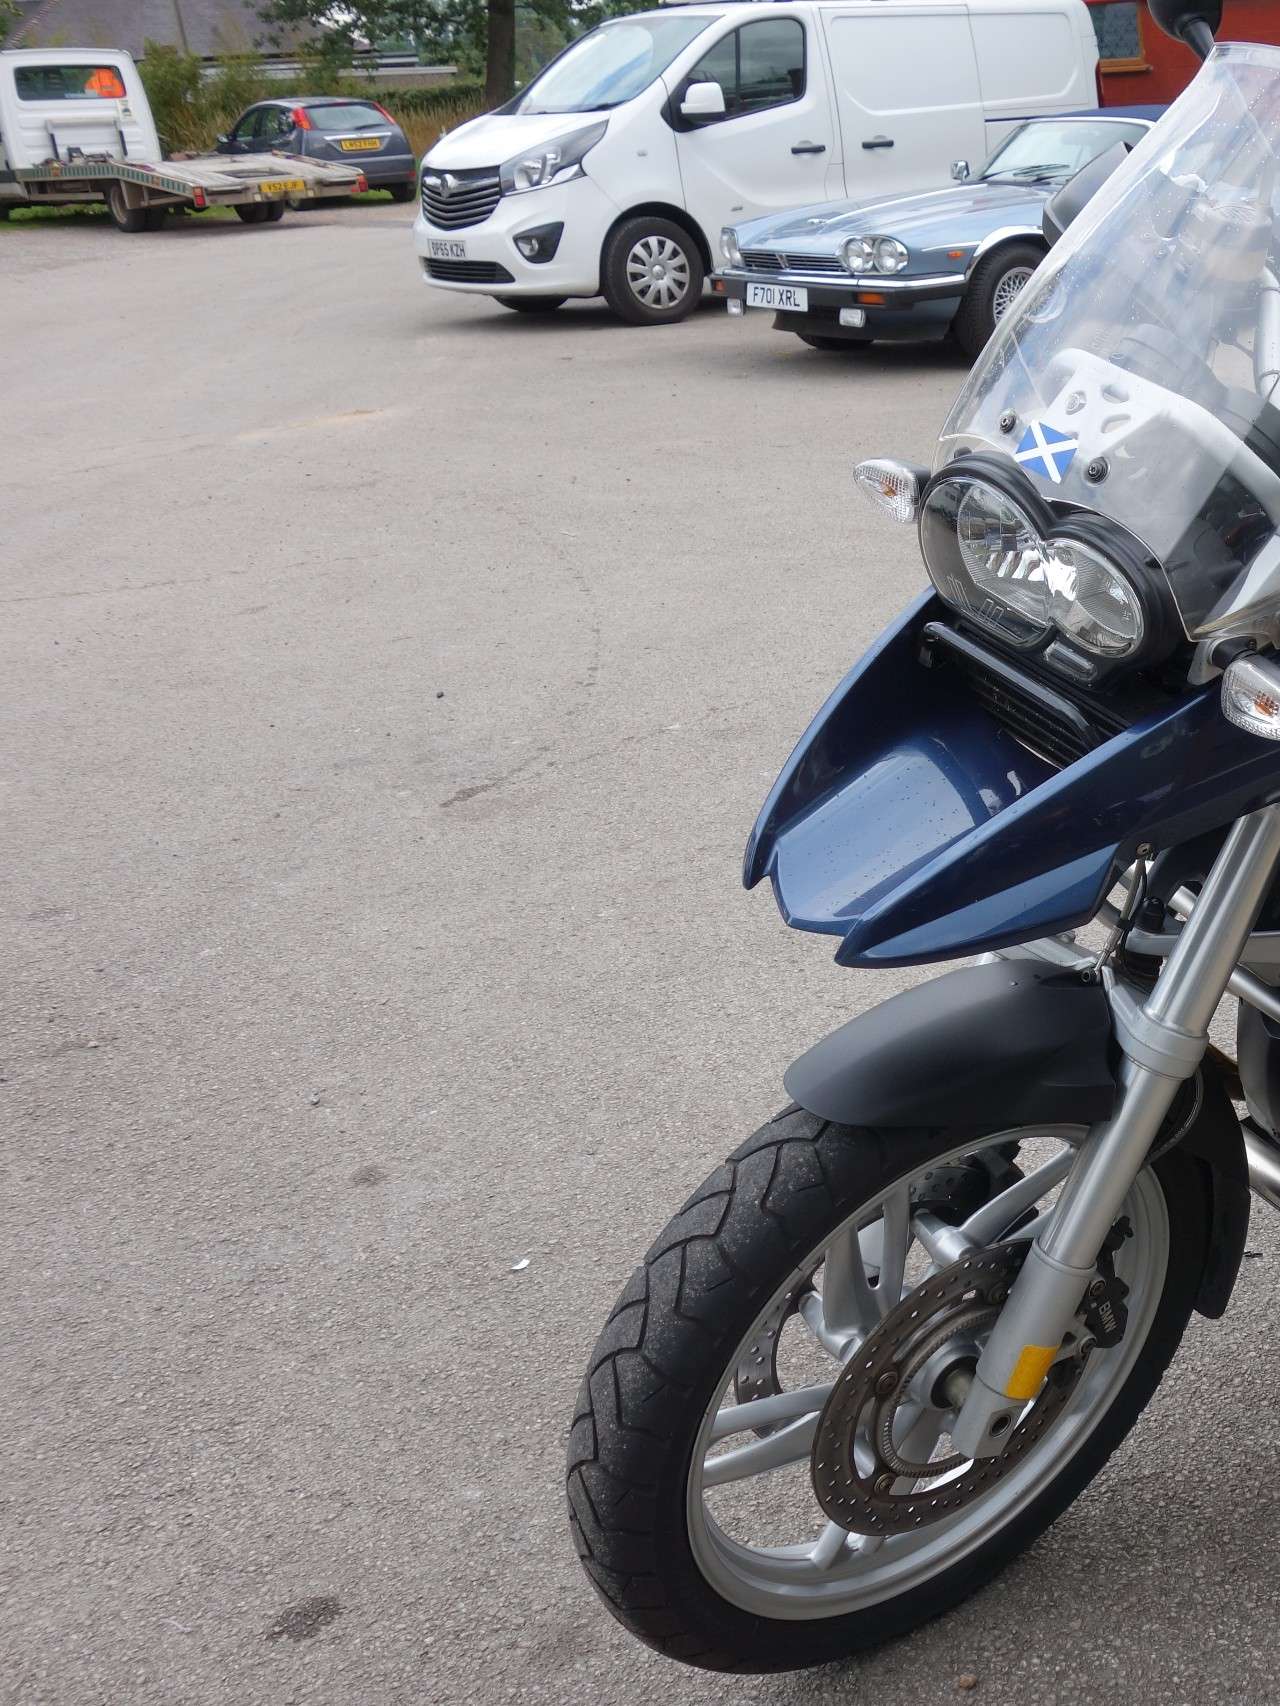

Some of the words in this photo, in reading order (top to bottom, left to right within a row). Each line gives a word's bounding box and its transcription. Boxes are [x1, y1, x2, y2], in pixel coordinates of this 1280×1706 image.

[753, 286, 775, 305] F701
[778, 288, 800, 307] XRL
[1099, 1300, 1119, 1333] BMW
